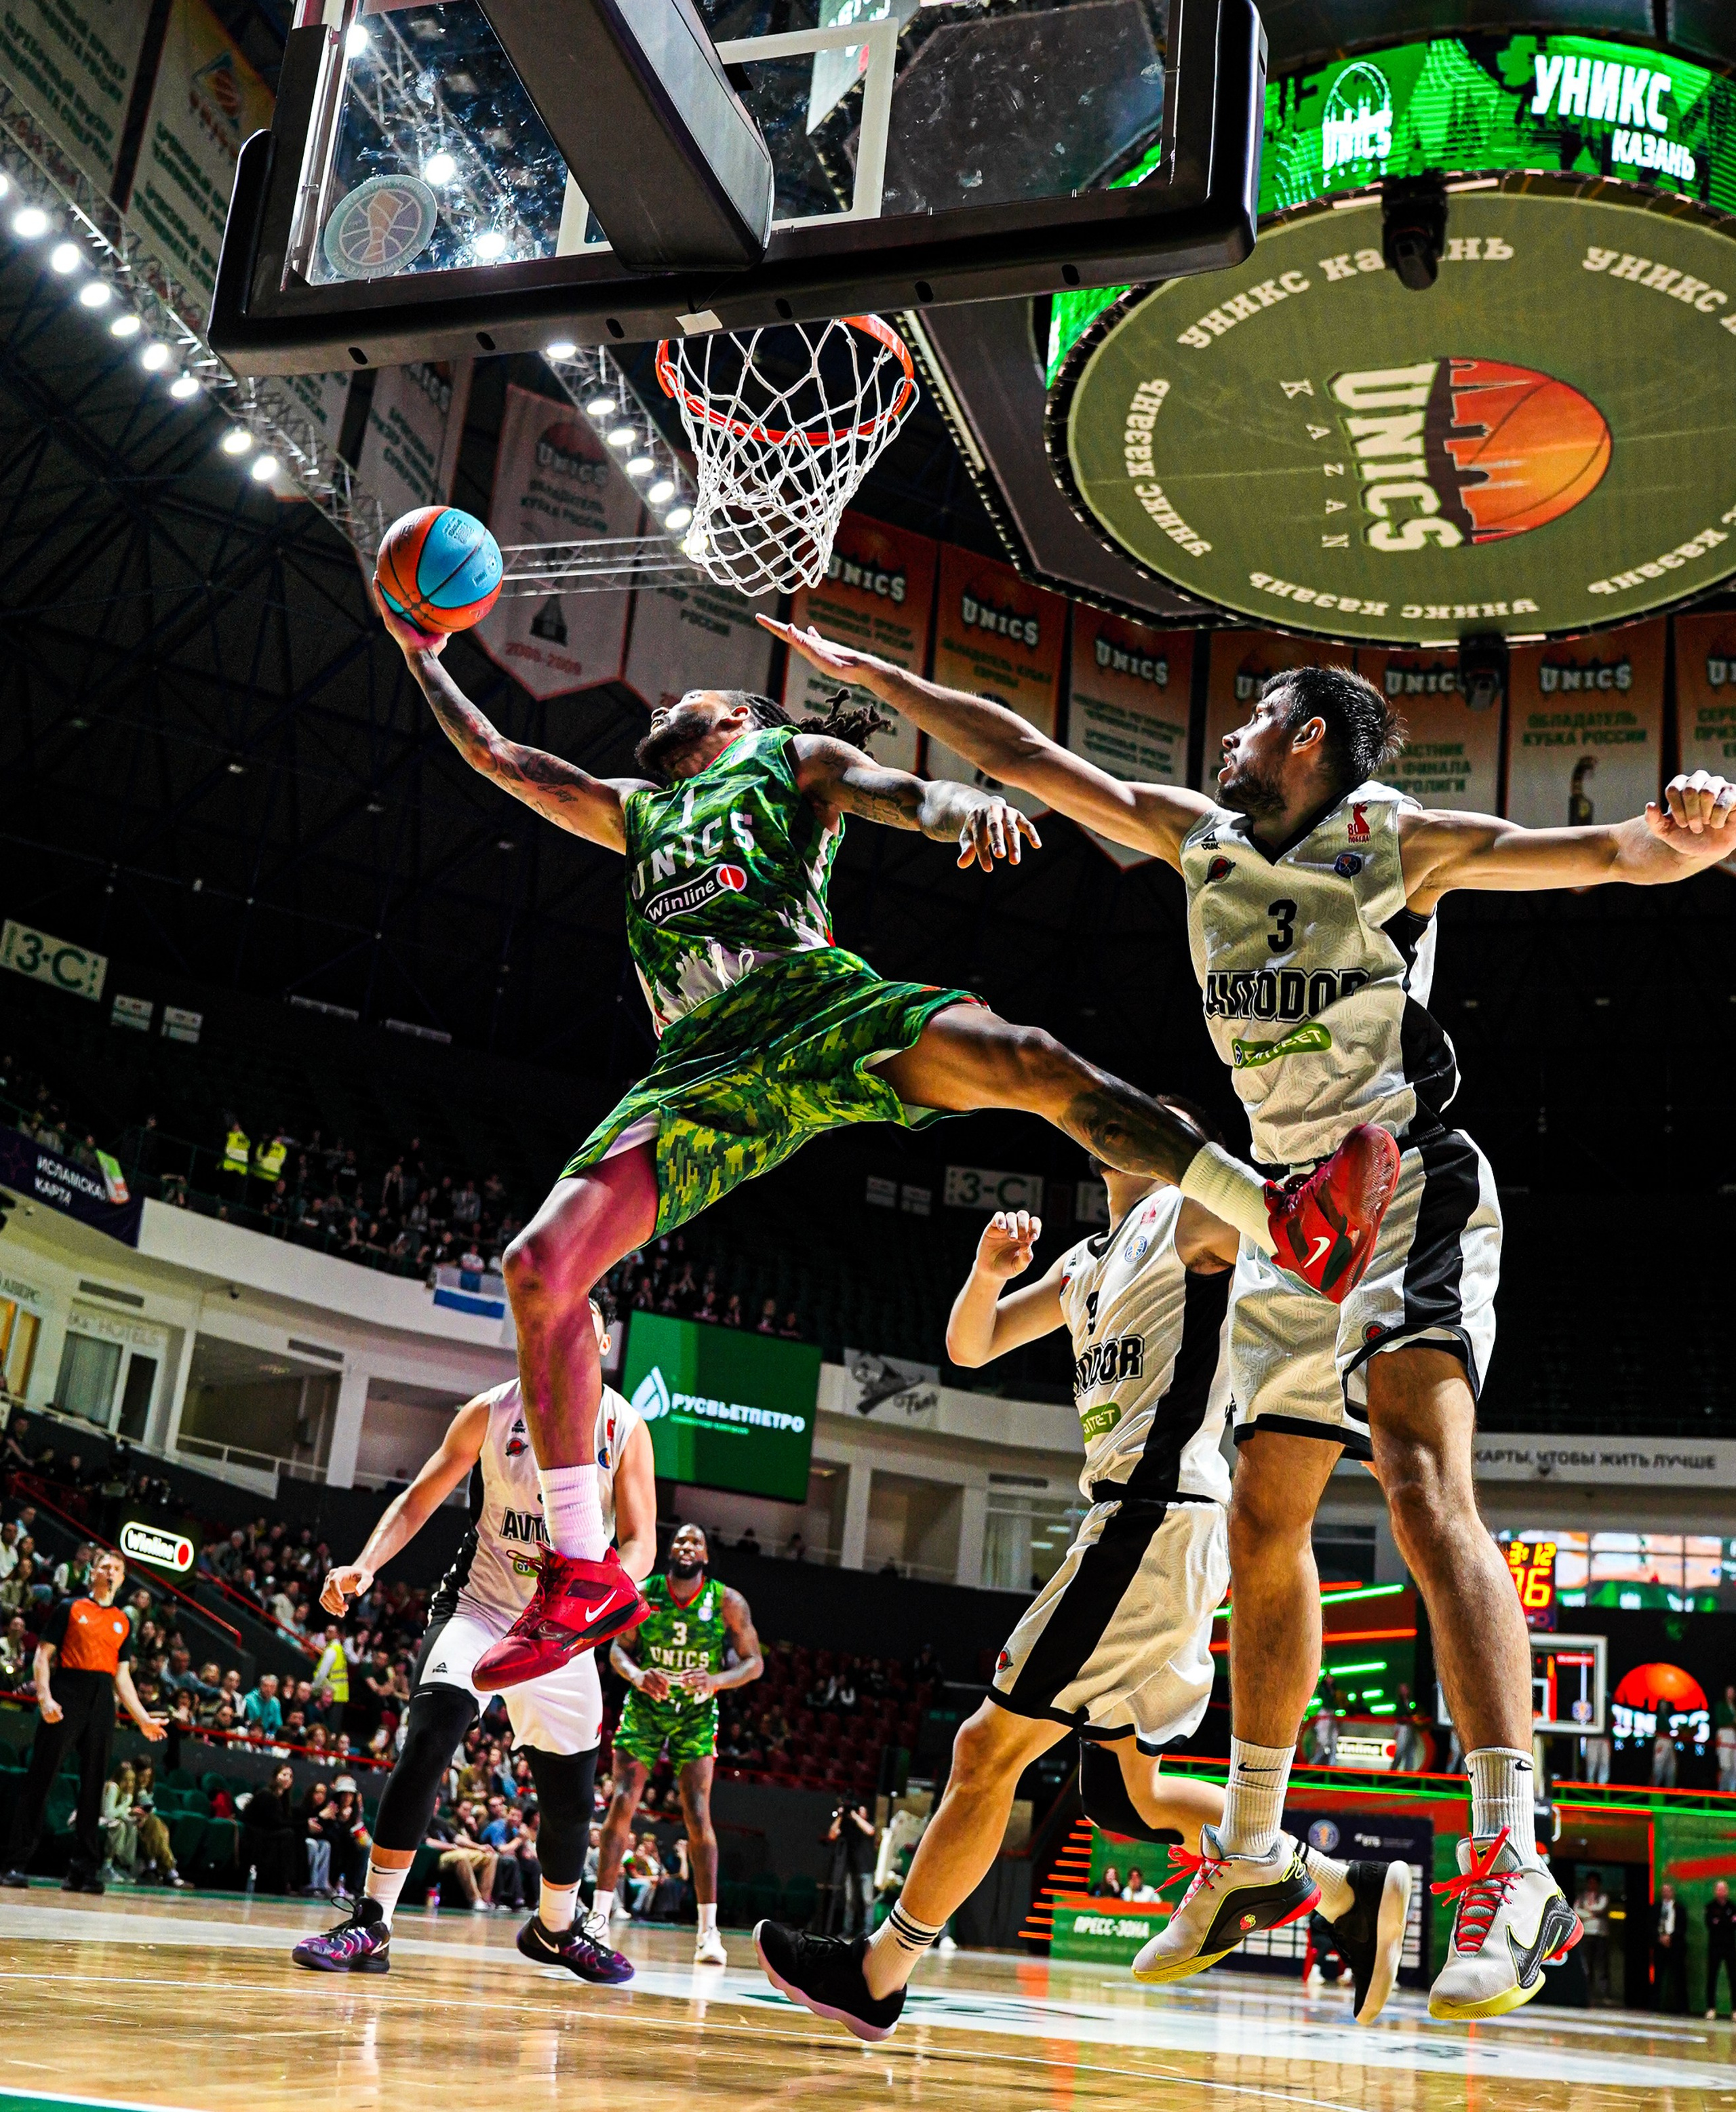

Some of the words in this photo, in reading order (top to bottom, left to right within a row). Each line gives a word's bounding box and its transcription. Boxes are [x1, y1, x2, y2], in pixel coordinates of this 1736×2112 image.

[1531, 54, 1672, 133] УНИКС
[1322, 110, 1393, 171] UNICS
[1611, 129, 1695, 181] КАЗАНЬ
[1279, 378, 1350, 549] KAZAN
[1331, 361, 1463, 552] UNICS
[827, 553, 907, 603] UNICS
[962, 595, 1040, 646] UNICS
[1095, 639, 1168, 685] UNICS
[1385, 671, 1465, 696] UNIC
[1540, 664, 1632, 692] UNICS
[679, 788, 694, 830] 1
[631, 811, 755, 900] UNICS
[648, 879, 715, 921] Winline
[1267, 898, 1298, 953] 3
[35, 1175, 73, 1206] КАРТА
[37, 1155, 108, 1203] ИСЛАМСКА
[671, 1393, 806, 1433] РУСВЬЕТПЕТРО
[1536, 1450, 1594, 1467] ЧТОБЫ
[1600, 1452, 1649, 1469] ЖИТЬ
[1653, 1454, 1717, 1470] ЛУЧШЕ
[672, 1621, 688, 1646] 3
[649, 1646, 710, 1669] UNICS
[1073, 1915, 1150, 1939] ПРЕСС-ЗОНА
